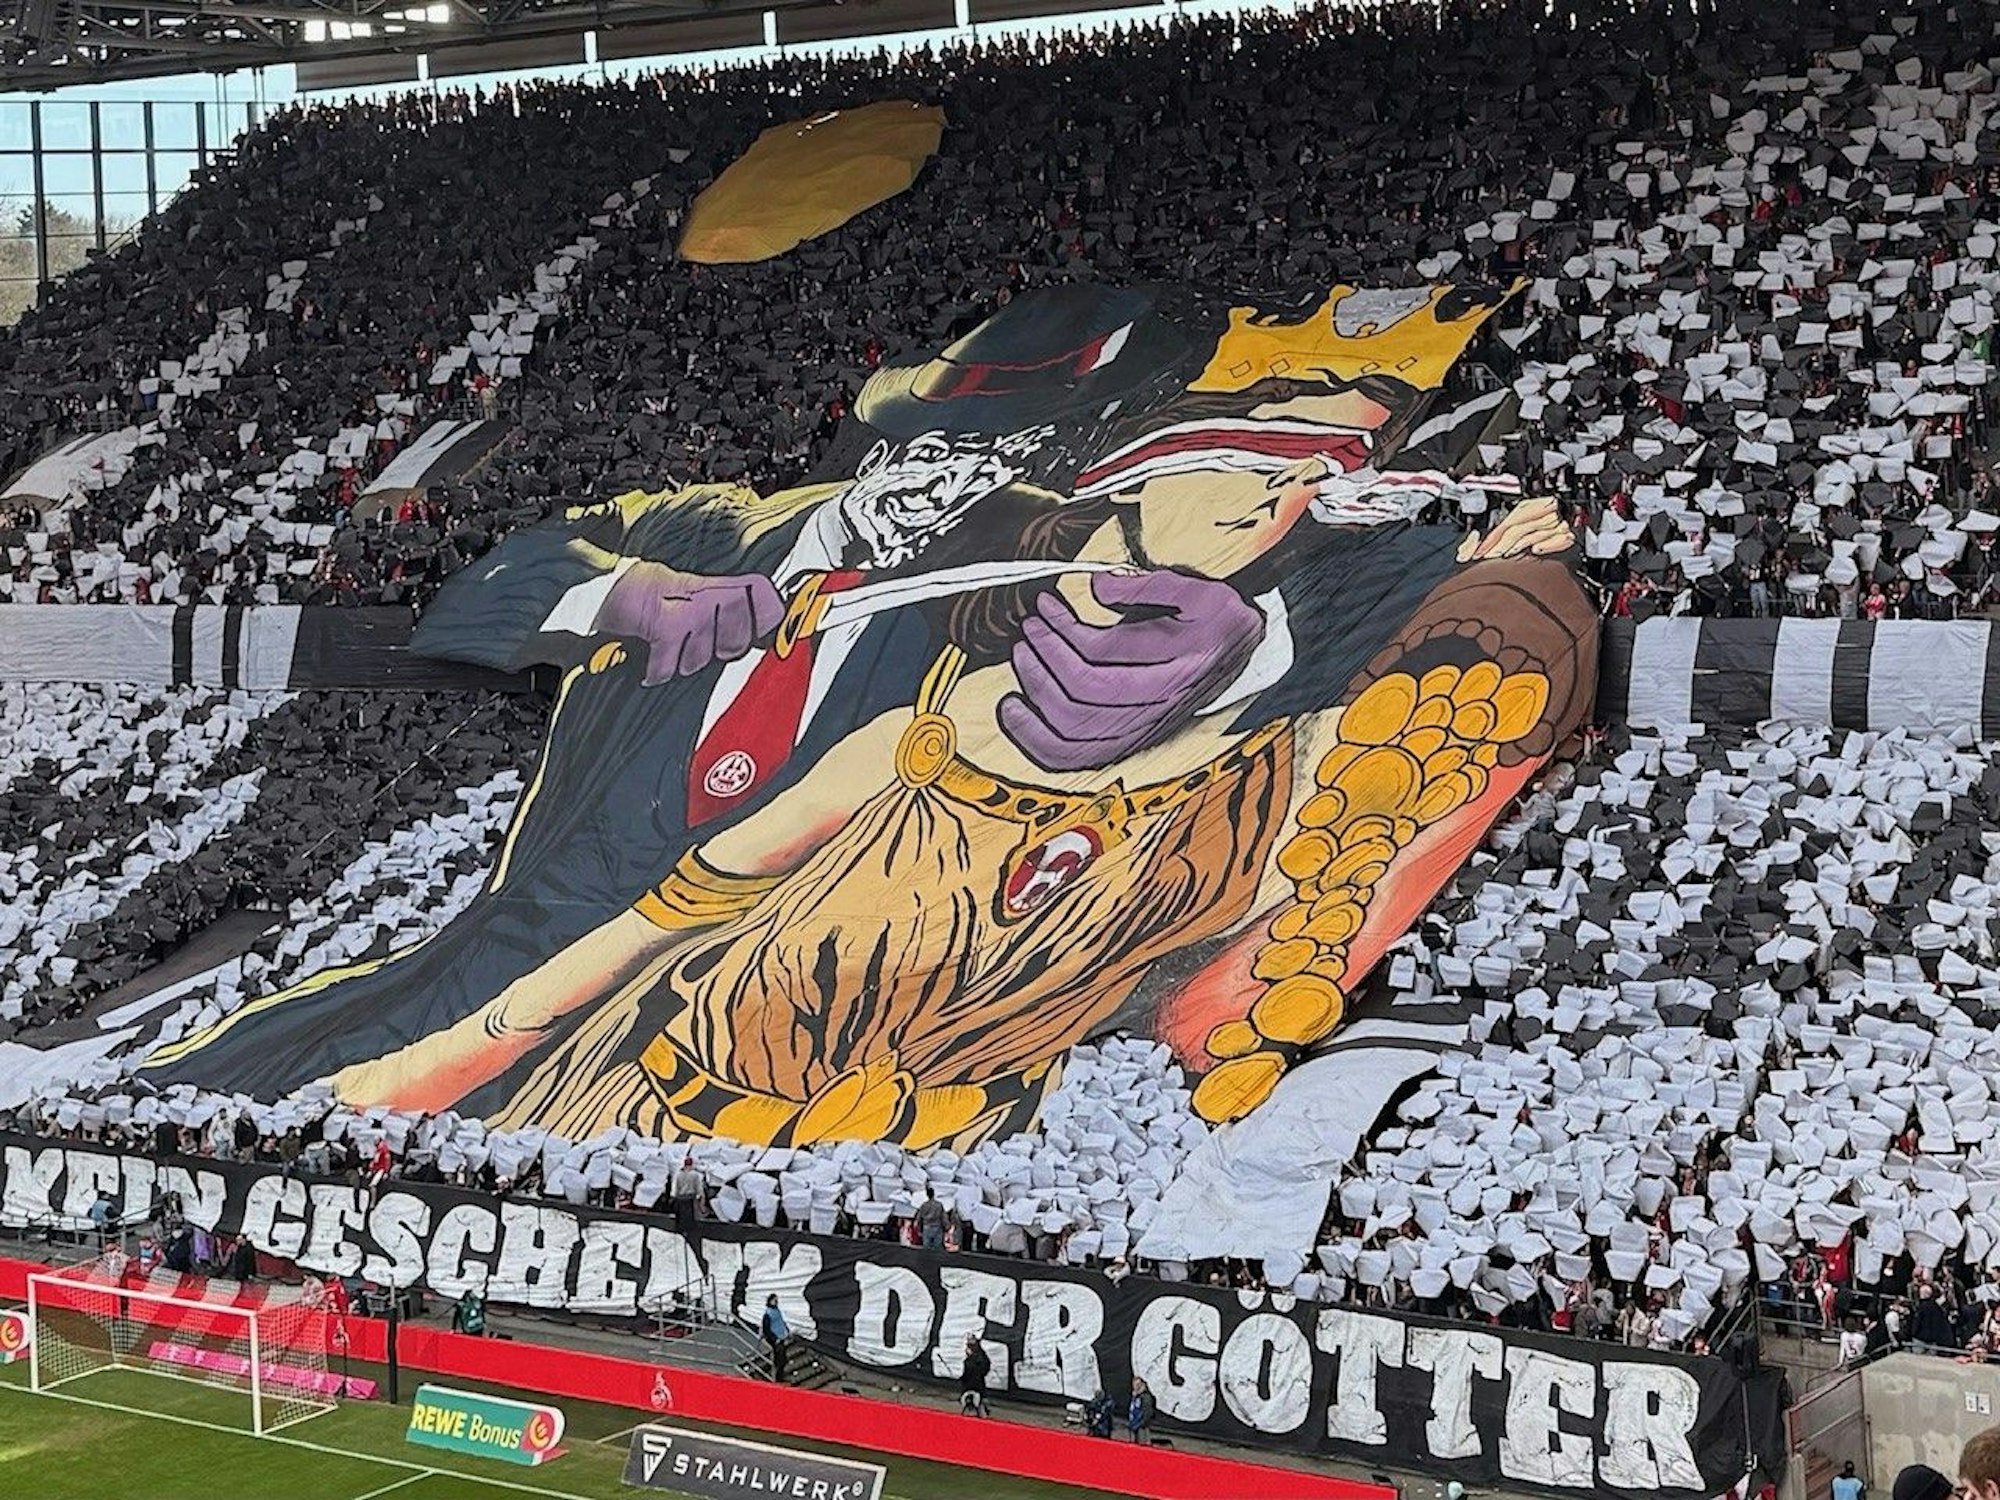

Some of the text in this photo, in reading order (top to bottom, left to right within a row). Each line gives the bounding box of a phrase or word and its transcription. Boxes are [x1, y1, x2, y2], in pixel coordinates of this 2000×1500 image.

[3, 1146, 1706, 1491] KEIN GESCHENK DER GÖTTER
[411, 1403, 522, 1449] REWE Bonus
